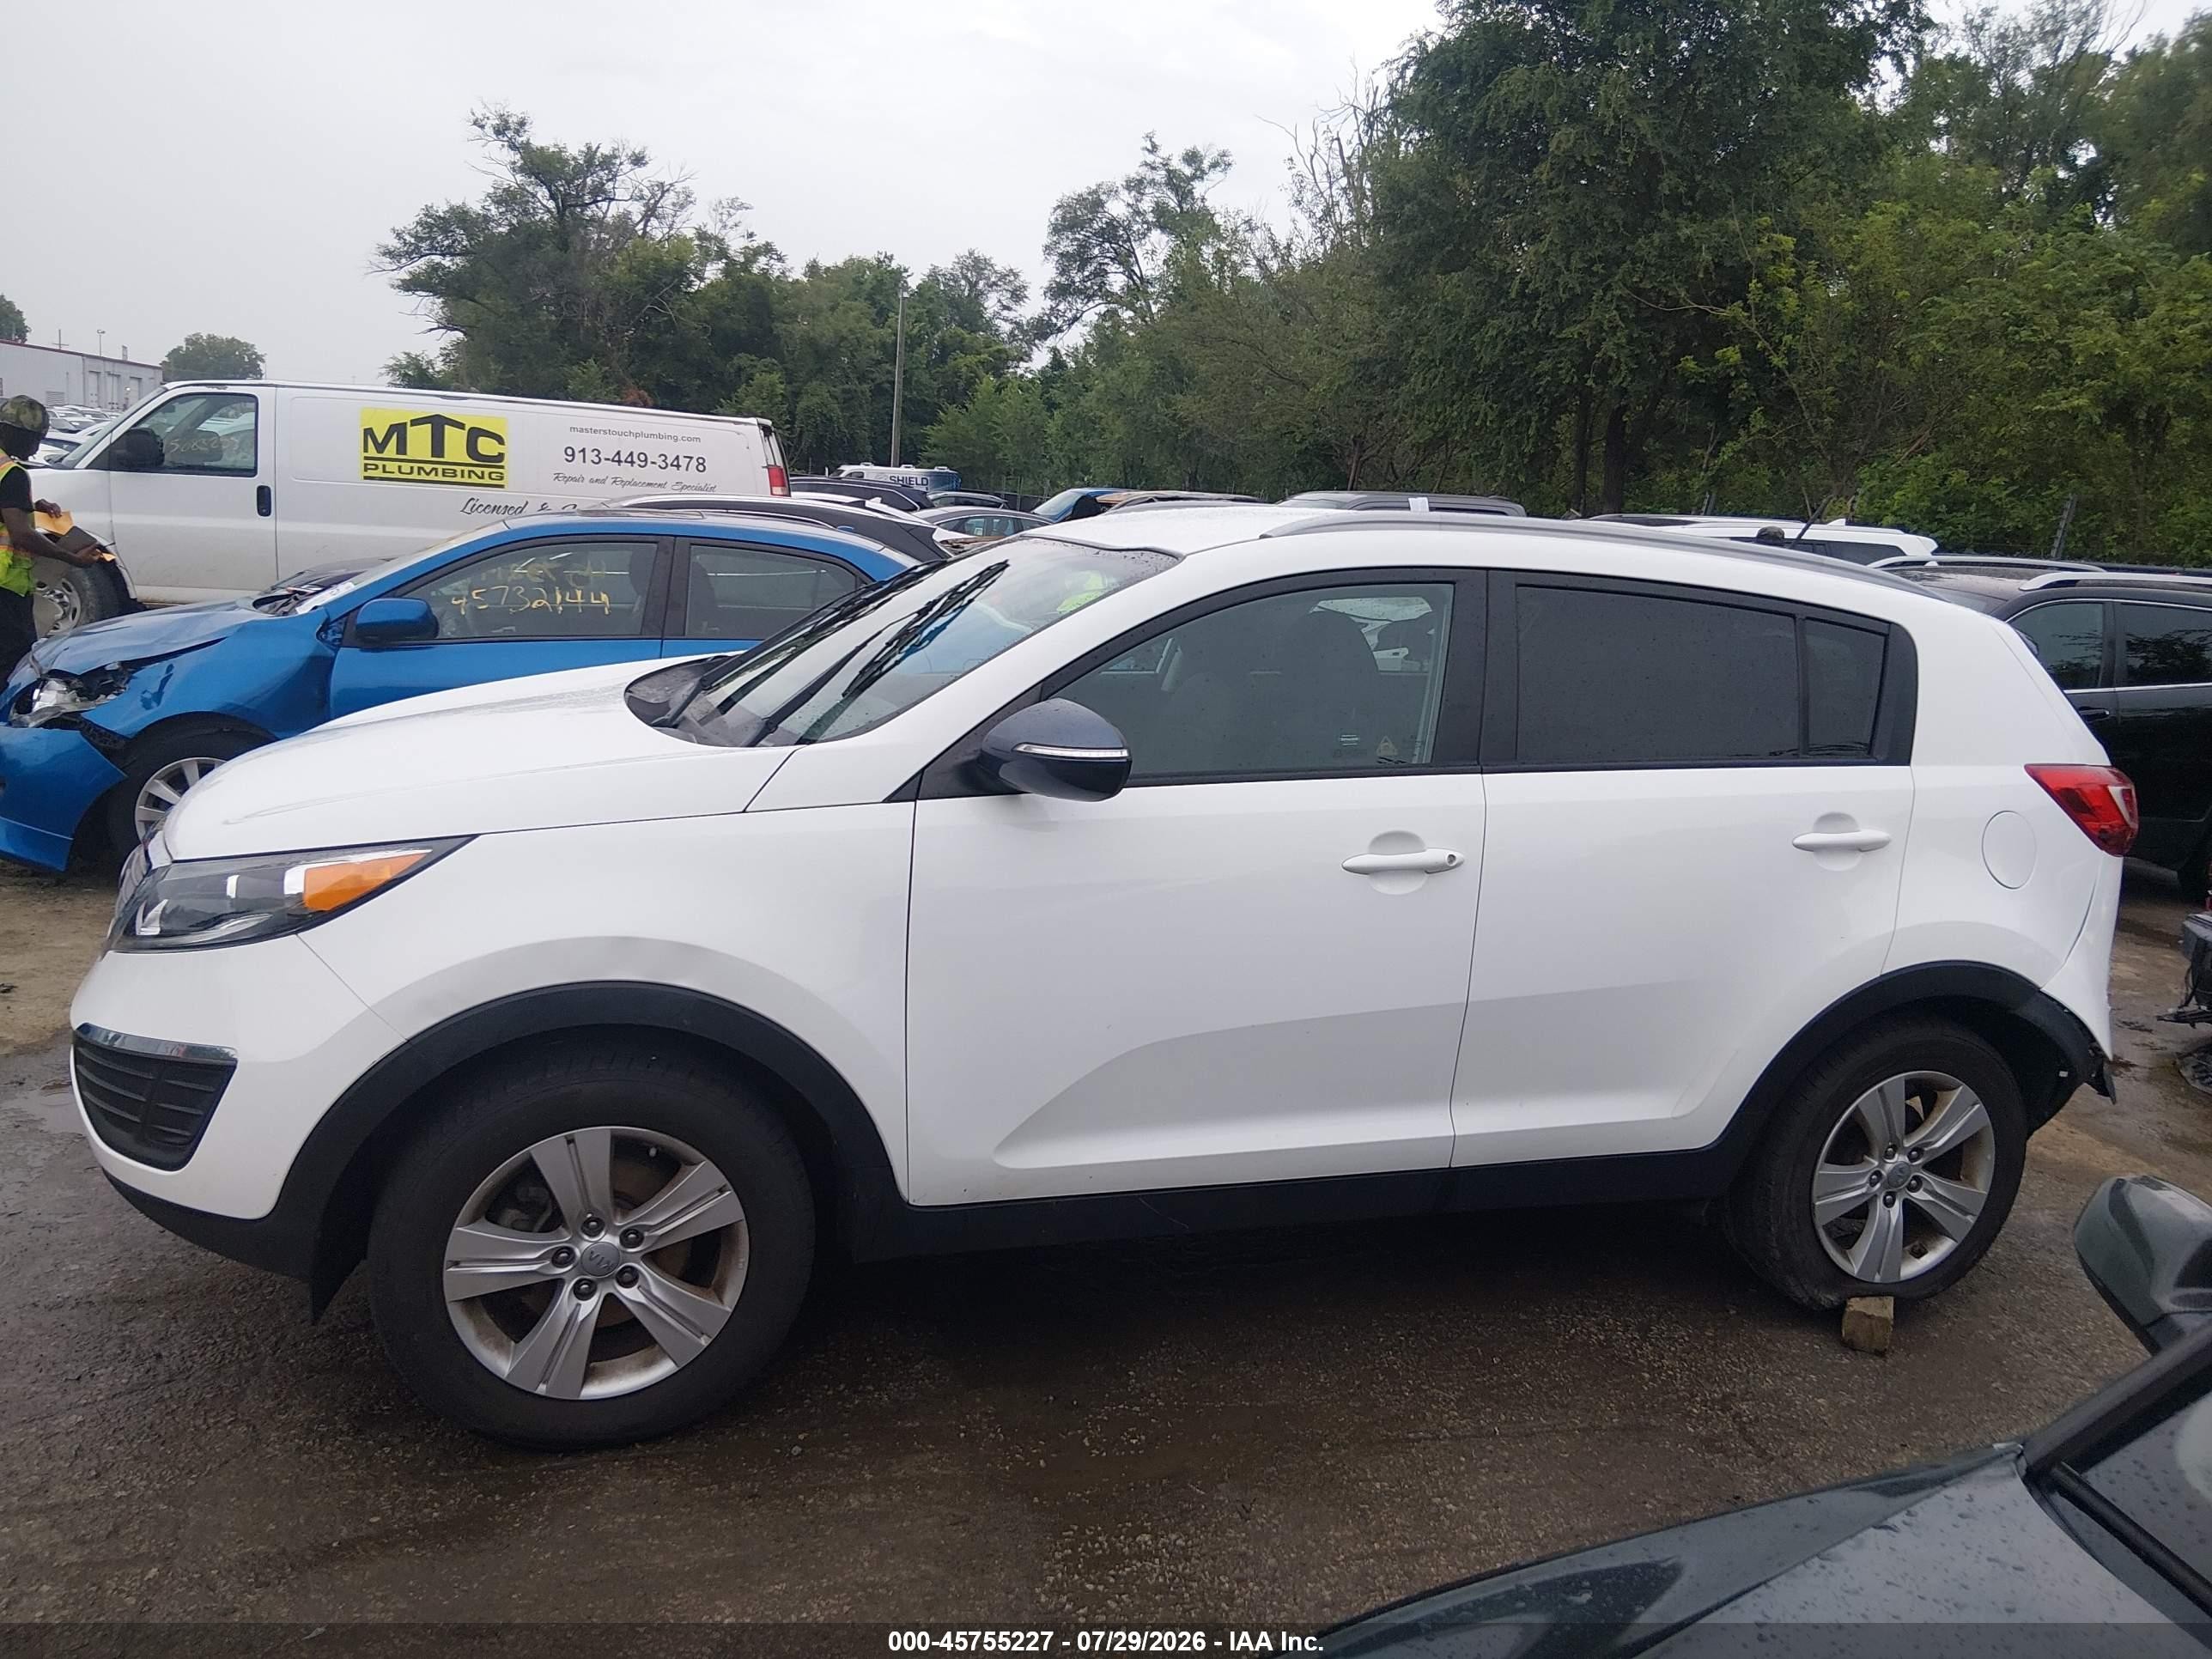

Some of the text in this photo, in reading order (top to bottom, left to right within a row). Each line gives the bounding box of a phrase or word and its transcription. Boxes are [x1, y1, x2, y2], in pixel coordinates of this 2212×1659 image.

[363, 414, 506, 464] MTC
[569, 425, 702, 444] masterstouchplumbing.com
[563, 446, 707, 473] 913-449-3478
[363, 463, 505, 482] PLUMBING
[889, 475, 929, 486] SHIELD
[553, 472, 718, 494] Repair and Replacement Specialist
[460, 497, 529, 515] Licensed
